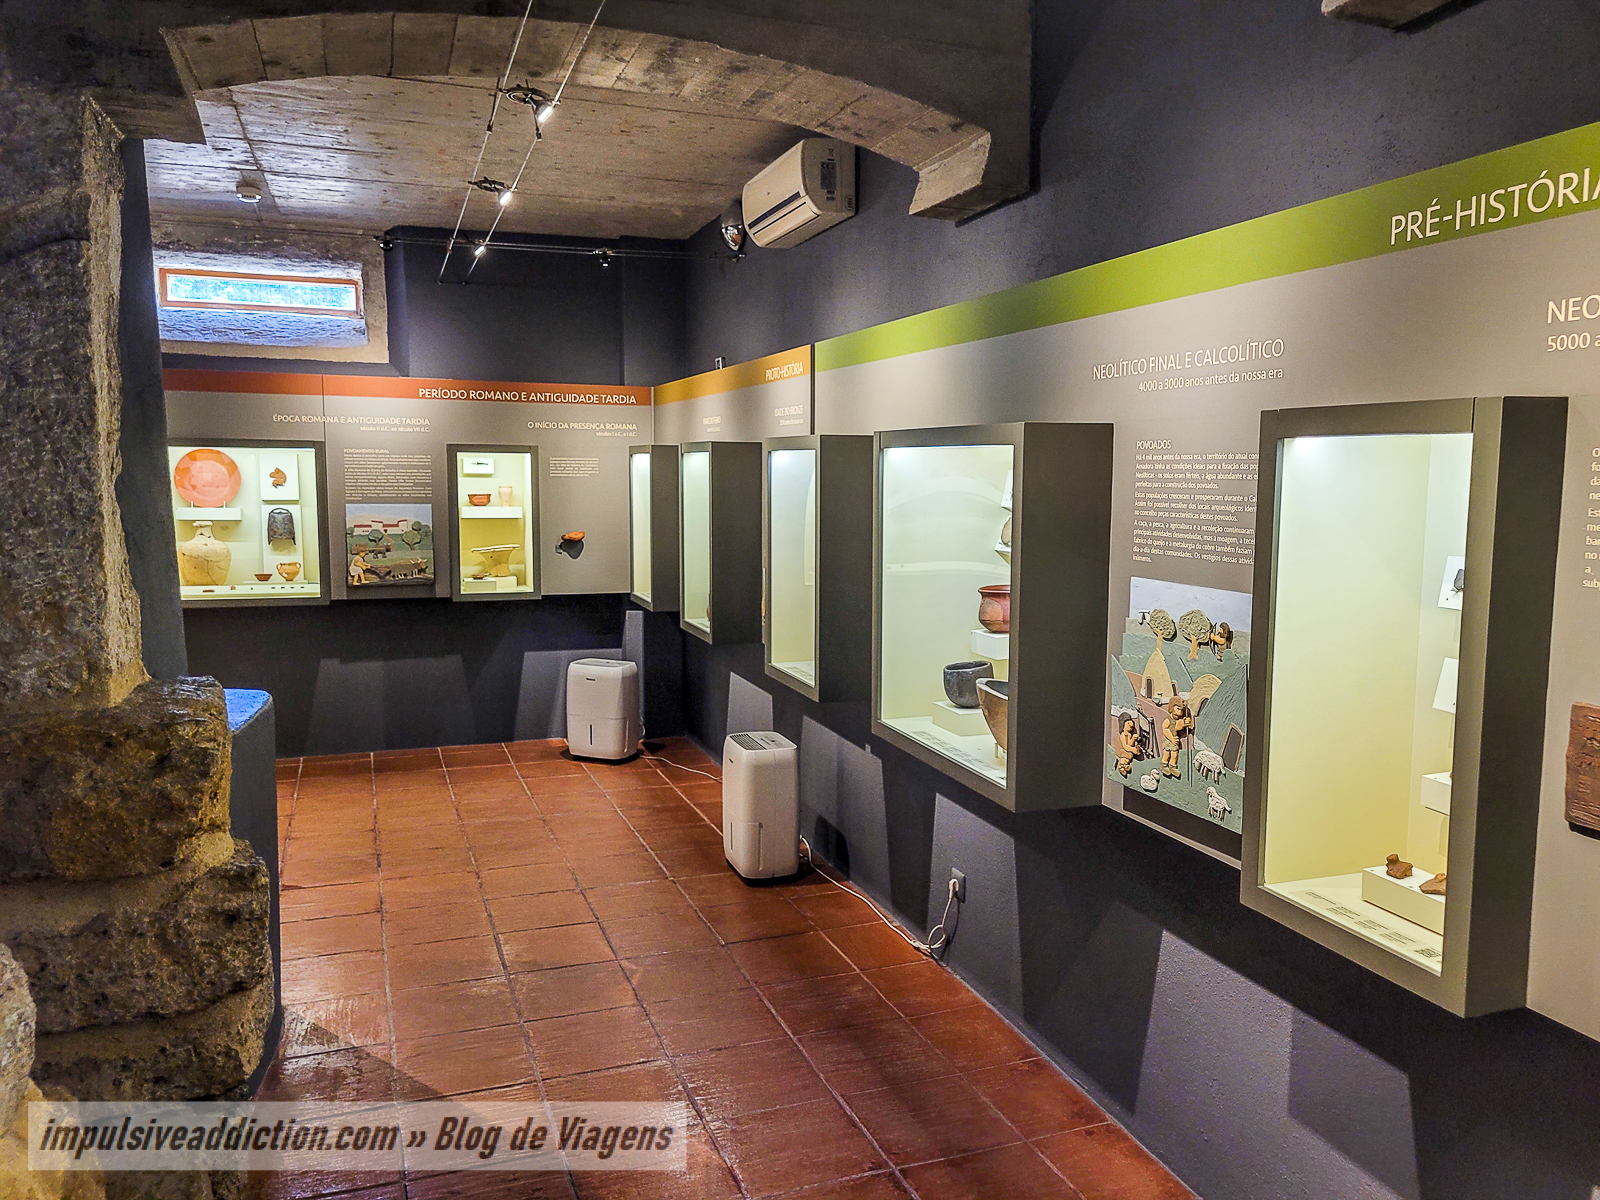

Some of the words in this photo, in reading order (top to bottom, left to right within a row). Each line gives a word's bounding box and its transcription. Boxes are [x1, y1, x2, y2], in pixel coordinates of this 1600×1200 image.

[1547, 332, 1590, 352] 5000
[1093, 358, 1147, 380] NEOLÍTICO
[1149, 353, 1182, 373] FINAL
[1185, 351, 1192, 368] E
[1194, 338, 1284, 367] CALCOLÍTICO
[765, 361, 804, 381] PROTO-HISTÓRIA
[1139, 380, 1158, 392] 4000
[1158, 382, 1163, 390] a
[1164, 377, 1184, 390] 3000
[1185, 377, 1204, 387] anos
[1205, 373, 1227, 386] antes
[1229, 370, 1240, 383] da
[1242, 370, 1266, 381] nossa
[1268, 368, 1283, 379] era
[419, 387, 467, 400] PERÍODO
[470, 390, 519, 401] ROMANO
[521, 391, 527, 401] E
[529, 392, 599, 403] ANTIGUIDADE
[601, 394, 637, 404] TARDIA
[273, 414, 300, 423] ÉPOCA
[302, 415, 339, 424] ROMANA
[341, 416, 345, 424] E
[347, 416, 401, 425] ANTIGUIDADE
[401, 417, 430, 426] TARDIA
[527, 421, 534, 429] O
[535, 420, 557, 429] INÍCIO
[570, 422, 604, 431] PRESENÇA
[605, 423, 638, 431] ROMANA
[1136, 440, 1171, 450] POVOADOS
[1207, 452, 1227, 460] território
[1228, 452, 1234, 460] do
[1235, 452, 1248, 460] atual
[1171, 463, 1192, 471] condições
[1207, 463, 1217, 471] para
[1222, 462, 1239, 471] fixação
[1206, 472, 1216, 480] água
[1217, 472, 1242, 480] abundante
[1165, 481, 1187, 490] construção
[1146, 491, 1168, 500] populações
[1224, 493, 1243, 502] durante
[1198, 502, 1210, 510] locais
[1211, 503, 1243, 513] arqueológicos
[1170, 522, 1192, 531] agricultura
[1236, 546, 1252, 554] faziam
[1584, 551, 1598, 560] no
[1194, 551, 1200, 559] Os
[1222, 554, 1237, 563] dessas
